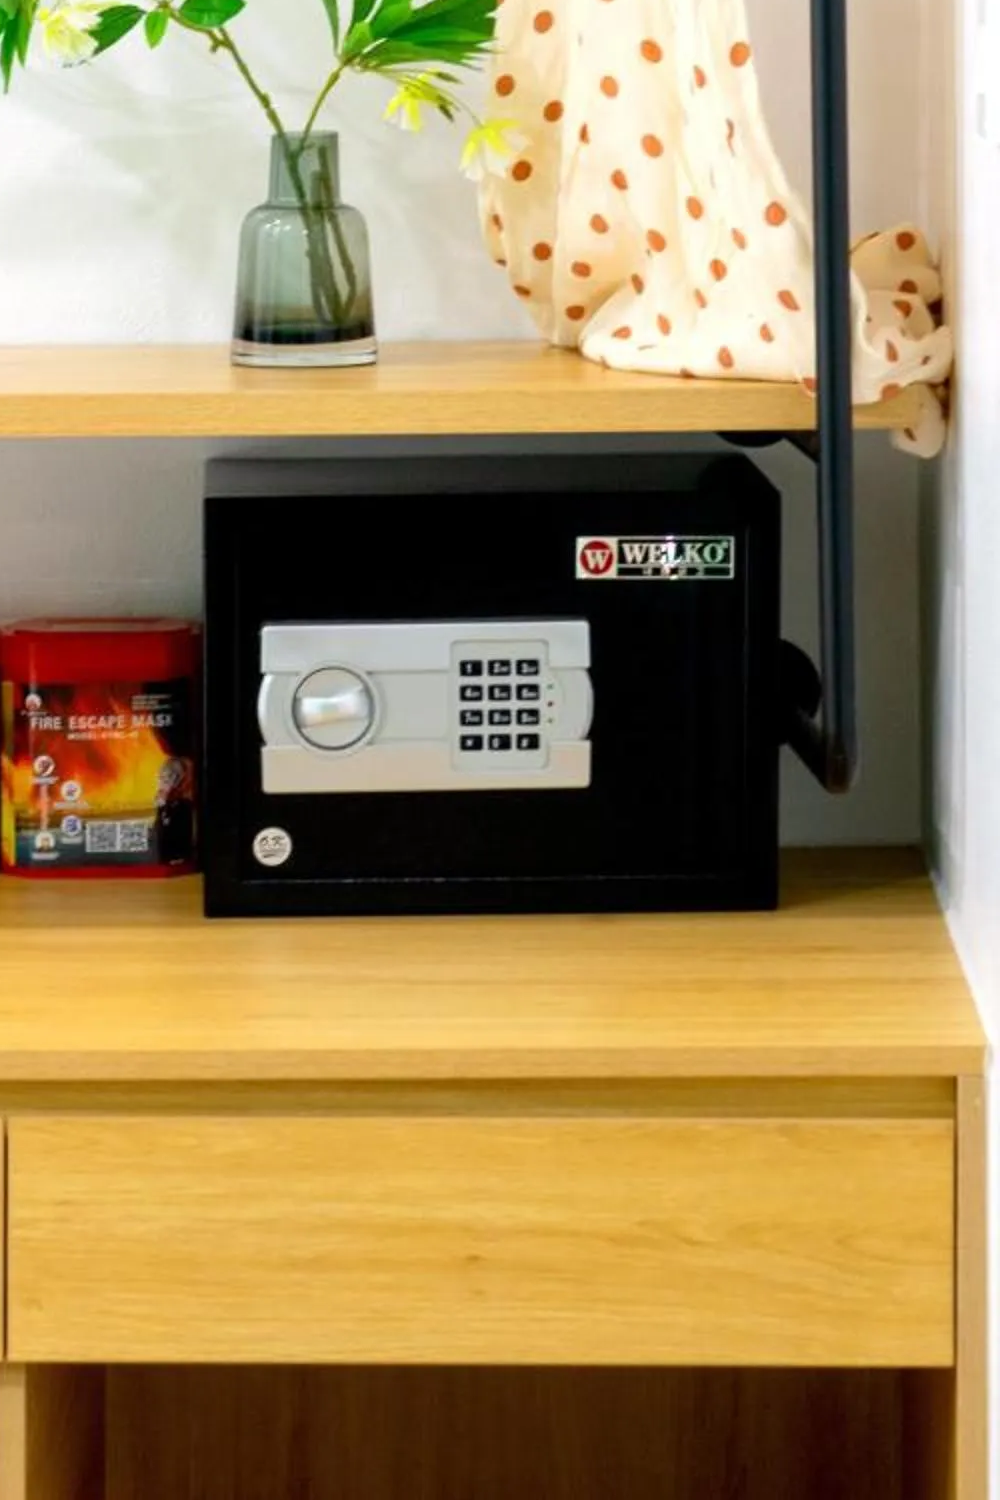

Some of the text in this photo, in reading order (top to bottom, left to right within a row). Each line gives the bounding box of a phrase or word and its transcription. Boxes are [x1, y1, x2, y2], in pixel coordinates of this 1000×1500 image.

[584, 549, 610, 571] W
[621, 542, 725, 564] WELKO
[30, 713, 174, 731] FIRE ESCAPE MASK
